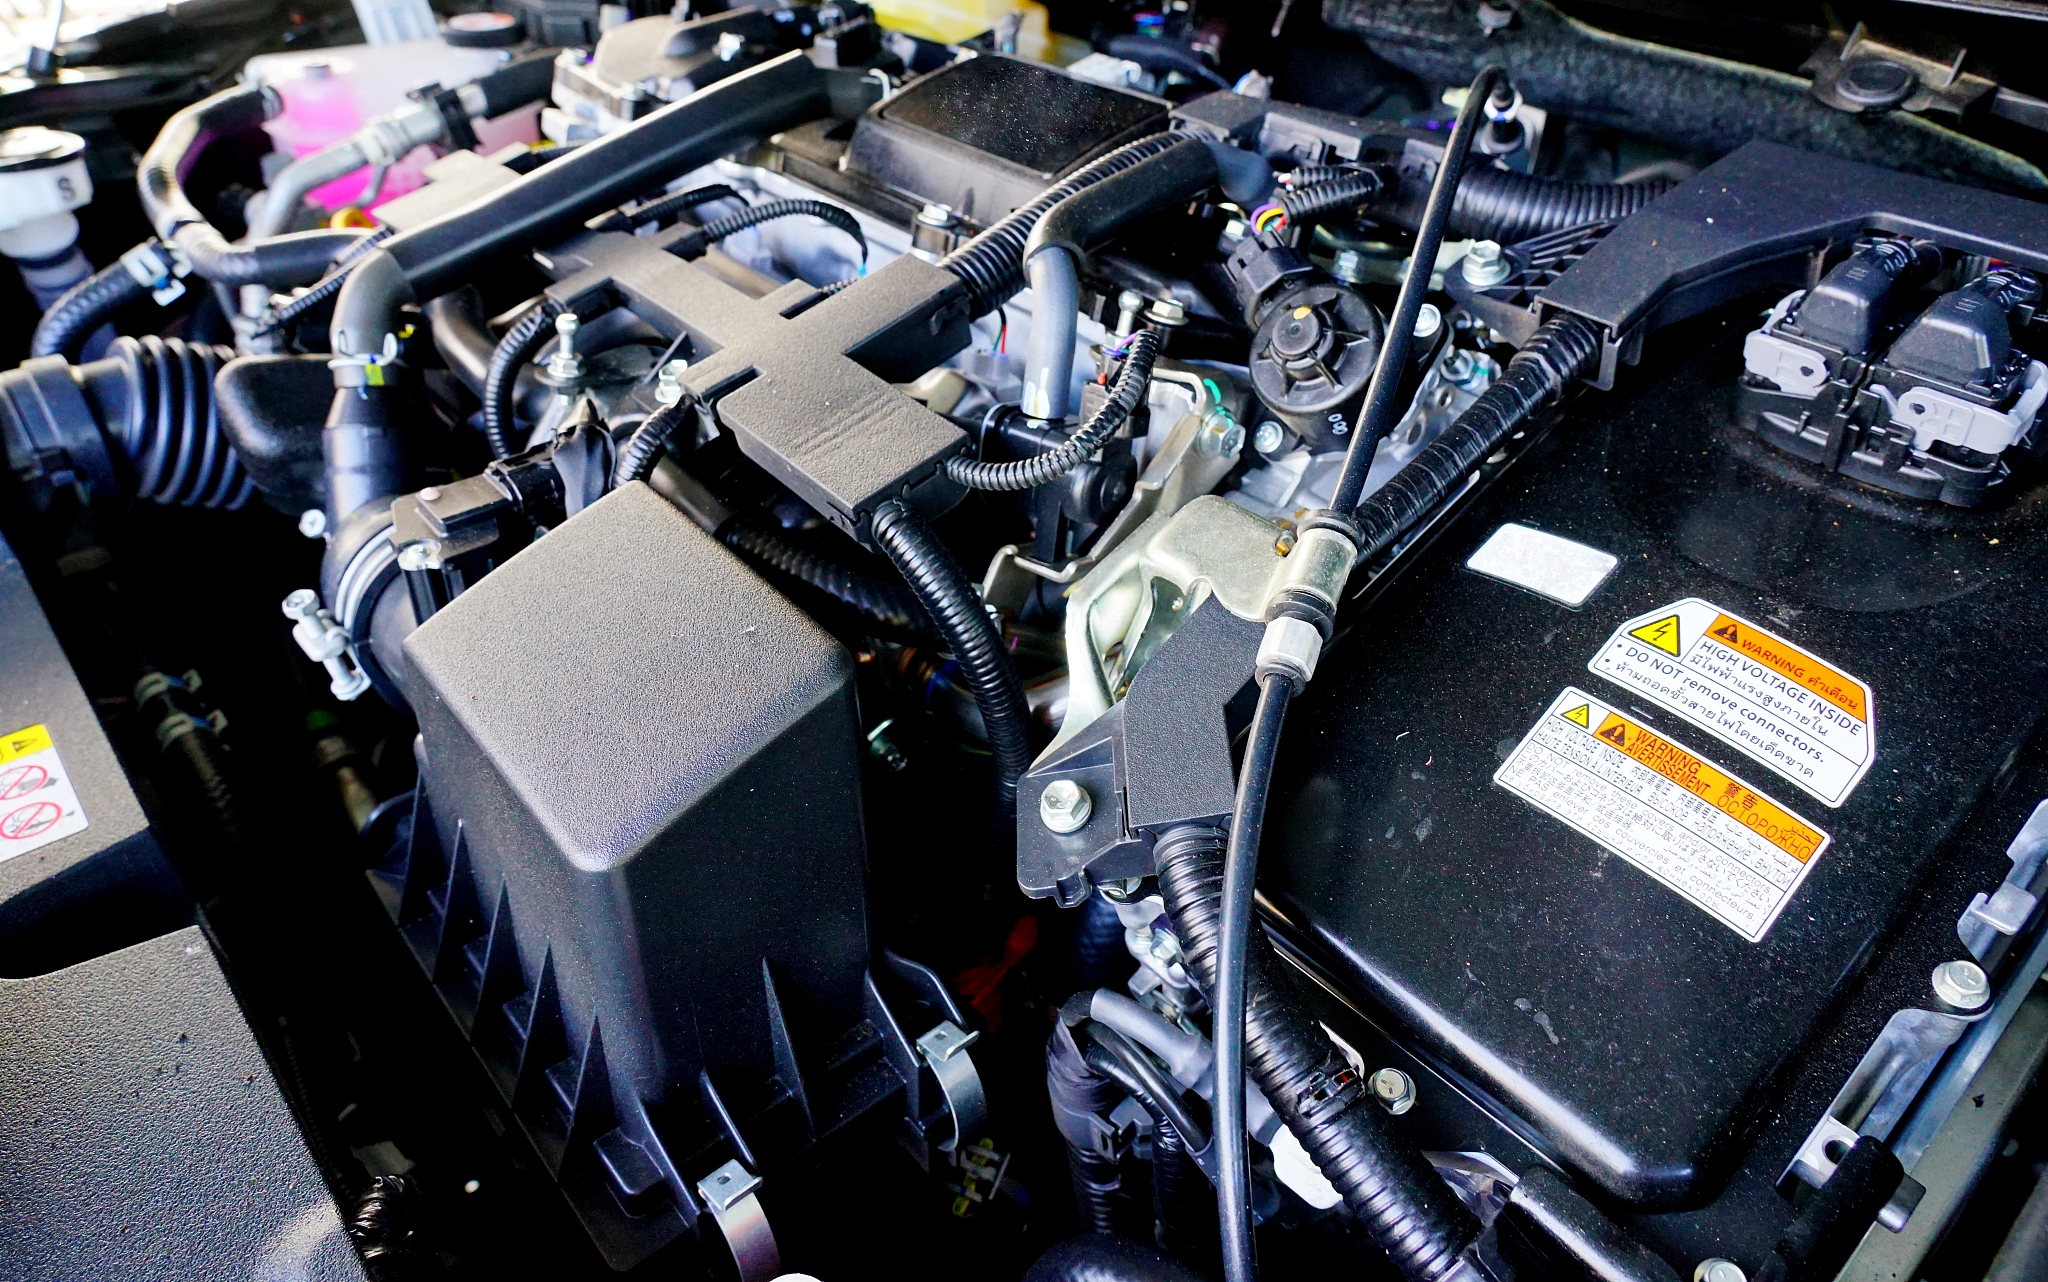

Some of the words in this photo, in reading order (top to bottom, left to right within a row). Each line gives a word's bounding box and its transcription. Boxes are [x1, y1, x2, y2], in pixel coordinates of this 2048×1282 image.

[1741, 638, 1805, 678] WARNING
[1624, 646, 1649, 663] DO
[1649, 657, 1684, 679] NOT
[1681, 676, 1738, 710] remove
[1739, 707, 1823, 763] connectors.
[1699, 640, 1740, 666] HIGH
[1741, 660, 1809, 704] VOLTAGE
[1807, 698, 1862, 736] INSIDE
[1807, 675, 1858, 710] คำเตือน
[1534, 729, 1562, 750] HAUTE
[1559, 742, 1592, 766] TENSION
[1543, 717, 1566, 735] HIGH
[1563, 727, 1601, 754] VOLTAGE
[1597, 746, 1627, 769] INSIDE
[1623, 741, 1711, 796] AVERTISSEMENT
[1634, 729, 1702, 776] WARNING
[1507, 764, 1526, 778] NE
[1526, 774, 1552, 792] PAS
[1551, 787, 1590, 815] enlever
[1591, 813, 1611, 829] ces
[1614, 827, 1670, 865] couvercles
[1673, 864, 1686, 875] et
[1525, 741, 1544, 755] DO
[1545, 752, 1571, 769] NOT
[1570, 767, 1607, 792] remove
[1610, 789, 1638, 810] these
[1639, 808, 1675, 834] covers
[1677, 831, 1712, 854] and/or
[1714, 854, 1772, 896] connectors.
[1723, 780, 1758, 809] 警告
[1715, 793, 1811, 860] ОСТОРОЖНО
[1753, 856, 1792, 887] внутри
